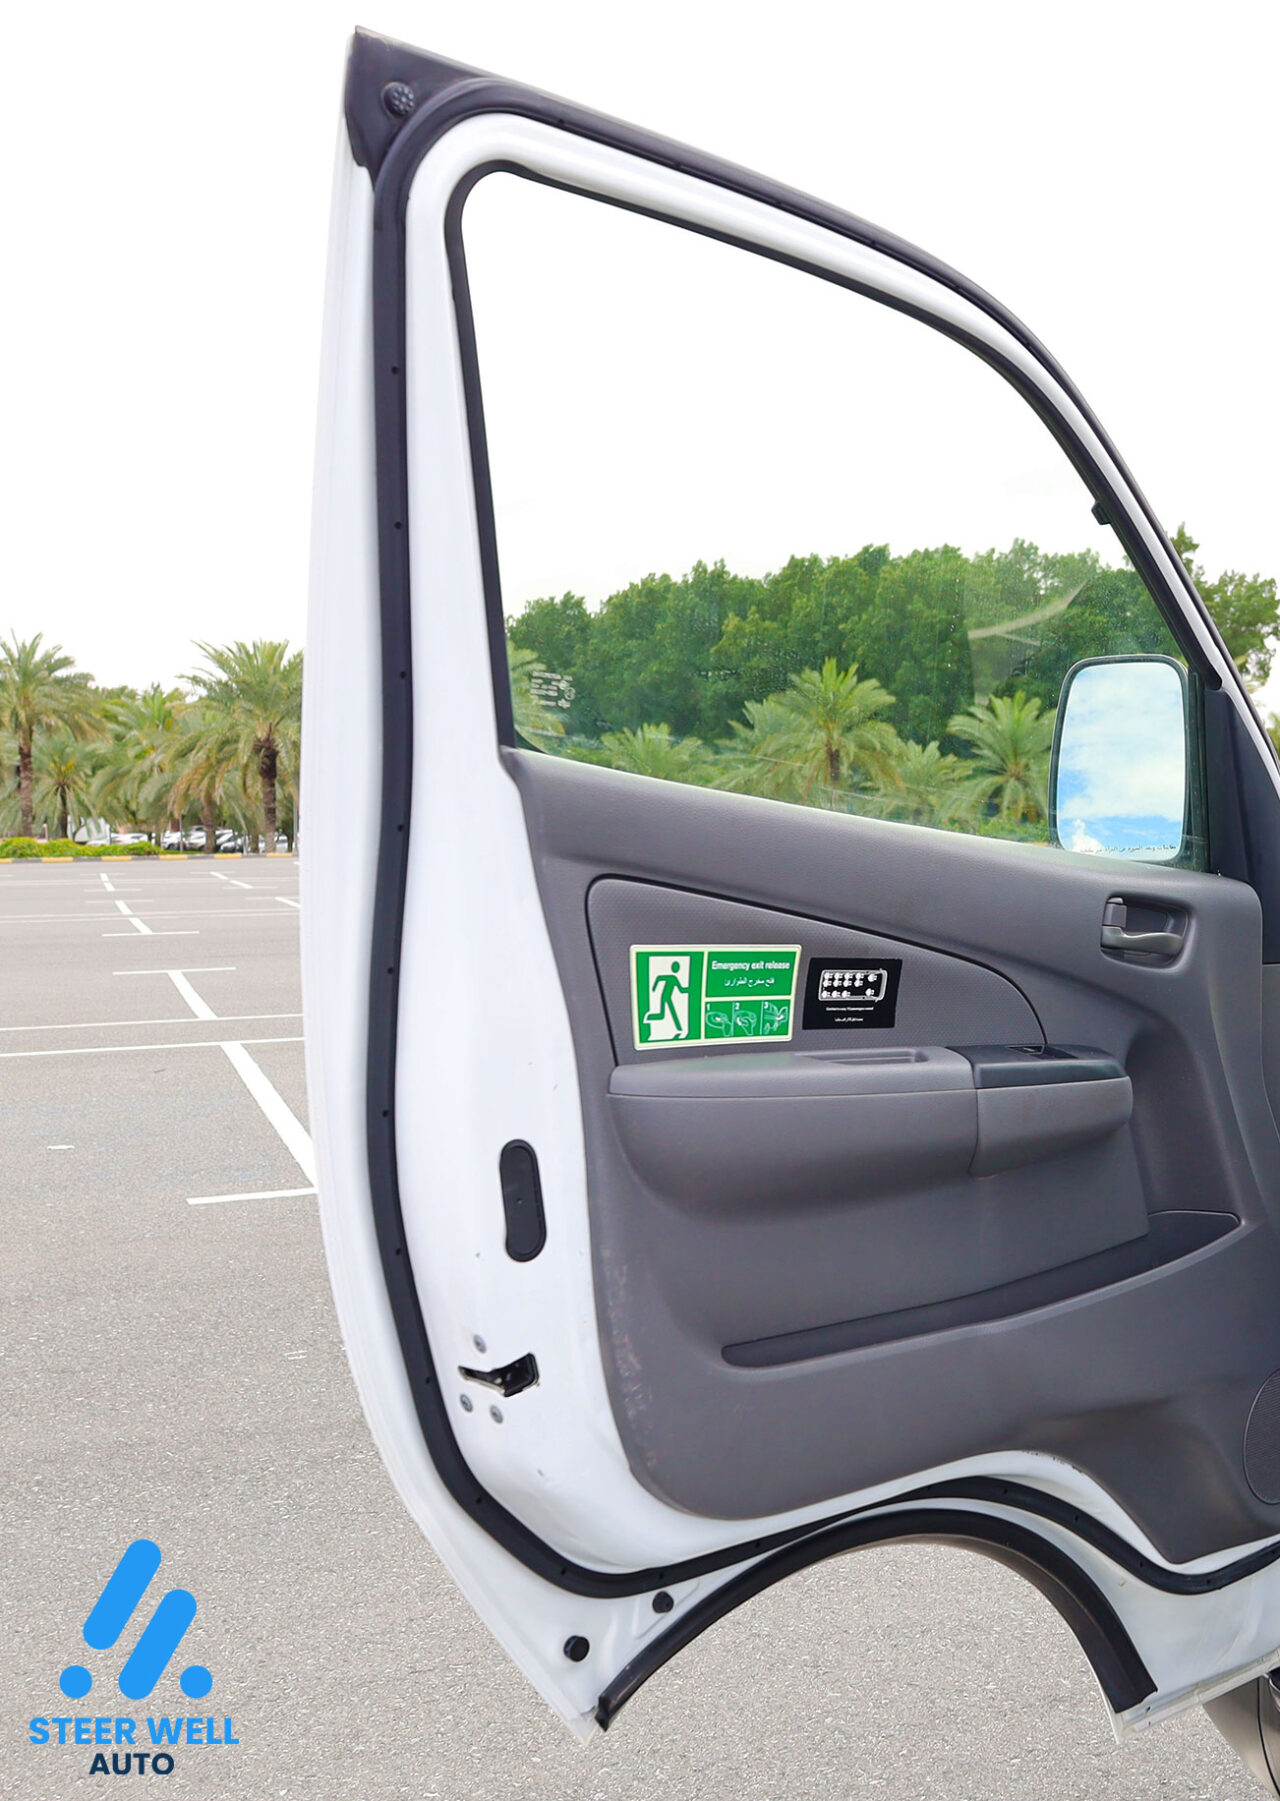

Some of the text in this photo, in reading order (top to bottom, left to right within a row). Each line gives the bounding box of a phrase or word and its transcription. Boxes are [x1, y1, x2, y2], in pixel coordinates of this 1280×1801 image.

[711, 960, 790, 971] Emergency exit release
